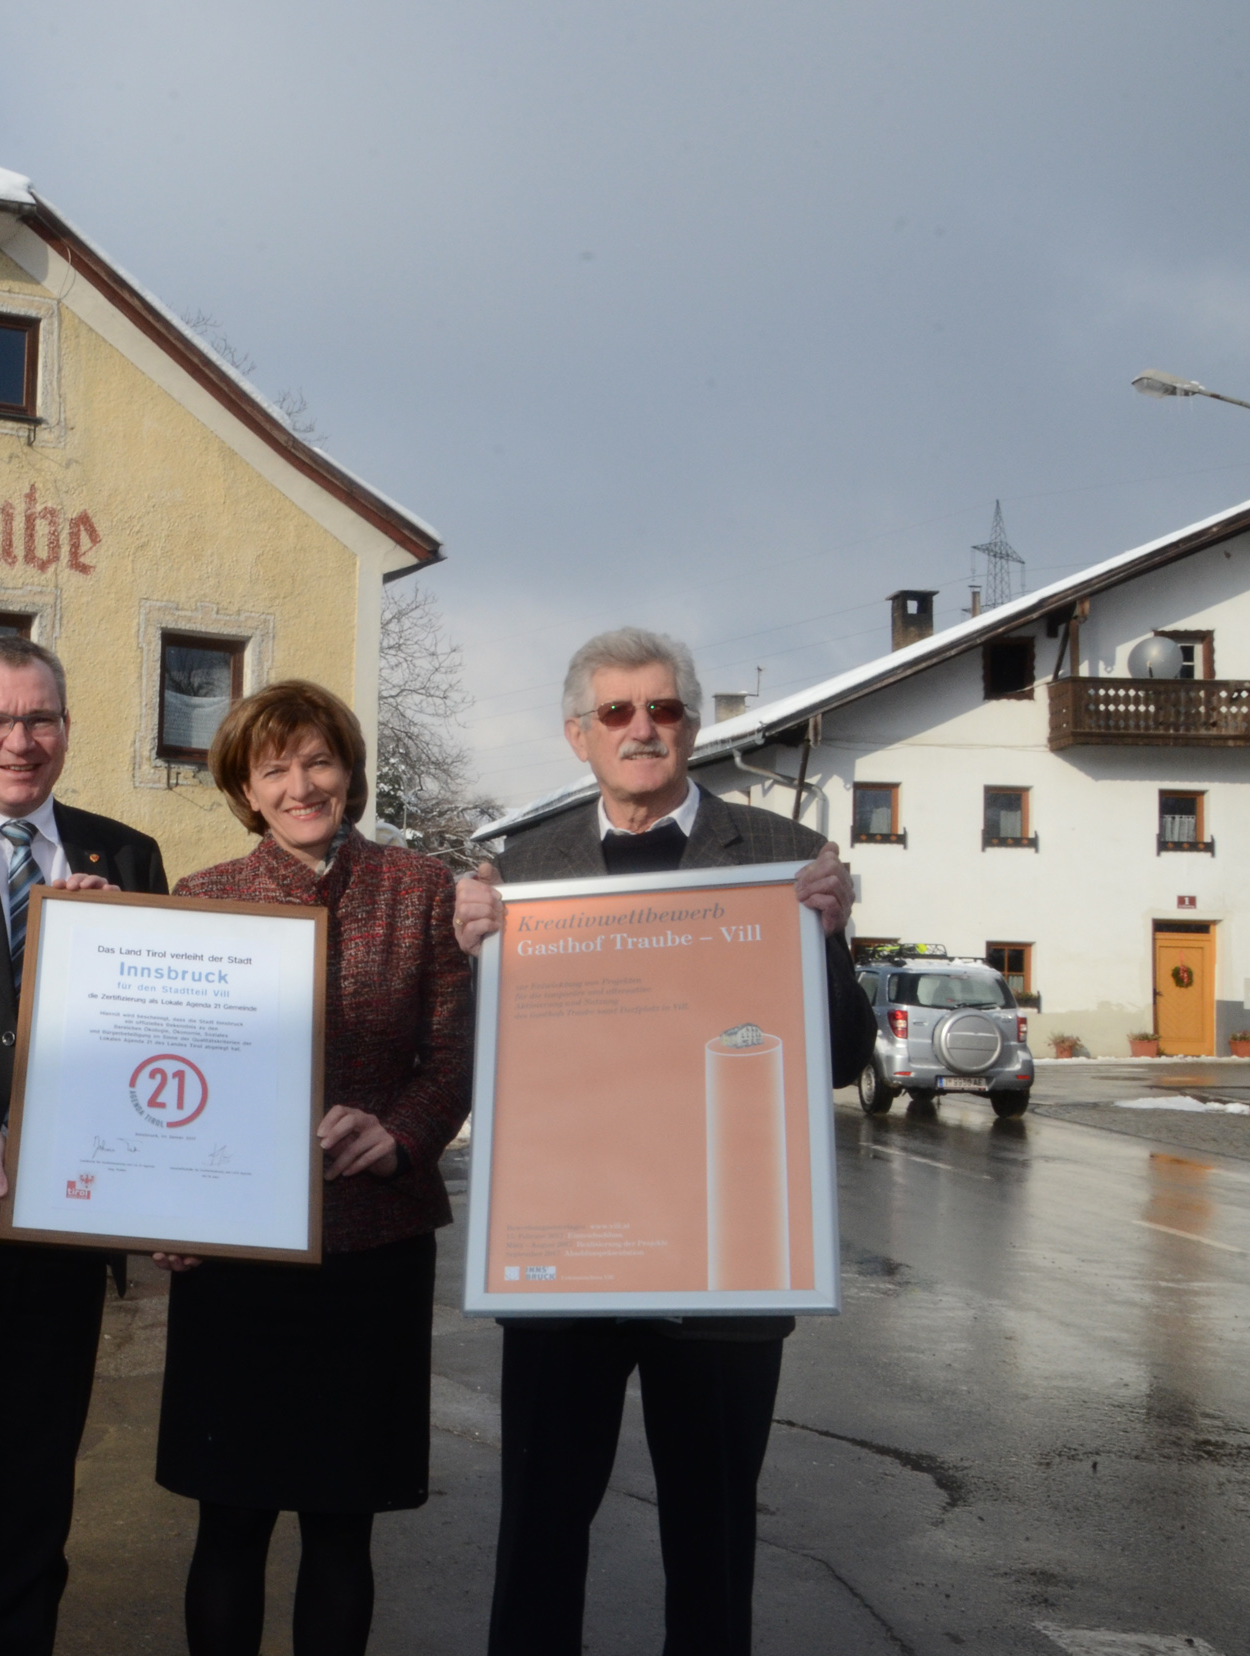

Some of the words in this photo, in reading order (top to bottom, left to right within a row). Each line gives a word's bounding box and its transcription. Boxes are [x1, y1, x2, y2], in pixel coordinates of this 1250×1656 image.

[517, 902, 726, 932] Kreativwettbewerb
[517, 935, 605, 956] Gasthof
[610, 930, 693, 950] Traube
[720, 924, 763, 942] Vill
[97, 945, 116, 955] Das
[119, 947, 142, 957] Land
[146, 949, 167, 959] Tirol
[170, 951, 204, 962] verleiht
[208, 954, 223, 963] der
[227, 956, 253, 966] Stadt
[119, 961, 229, 984] Innsbruck
[117, 981, 132, 991] für
[137, 983, 157, 992] den
[162, 985, 208, 997] Stadtteil
[213, 989, 230, 998] Vill
[101, 993, 146, 1005] Zertifizierung
[161, 999, 183, 1007] Lokale
[186, 1001, 211, 1010] Agenda
[223, 1003, 257, 1013] Gemeinde
[147, 1067, 185, 1110] 21
[67, 1188, 88, 1196] tirol
